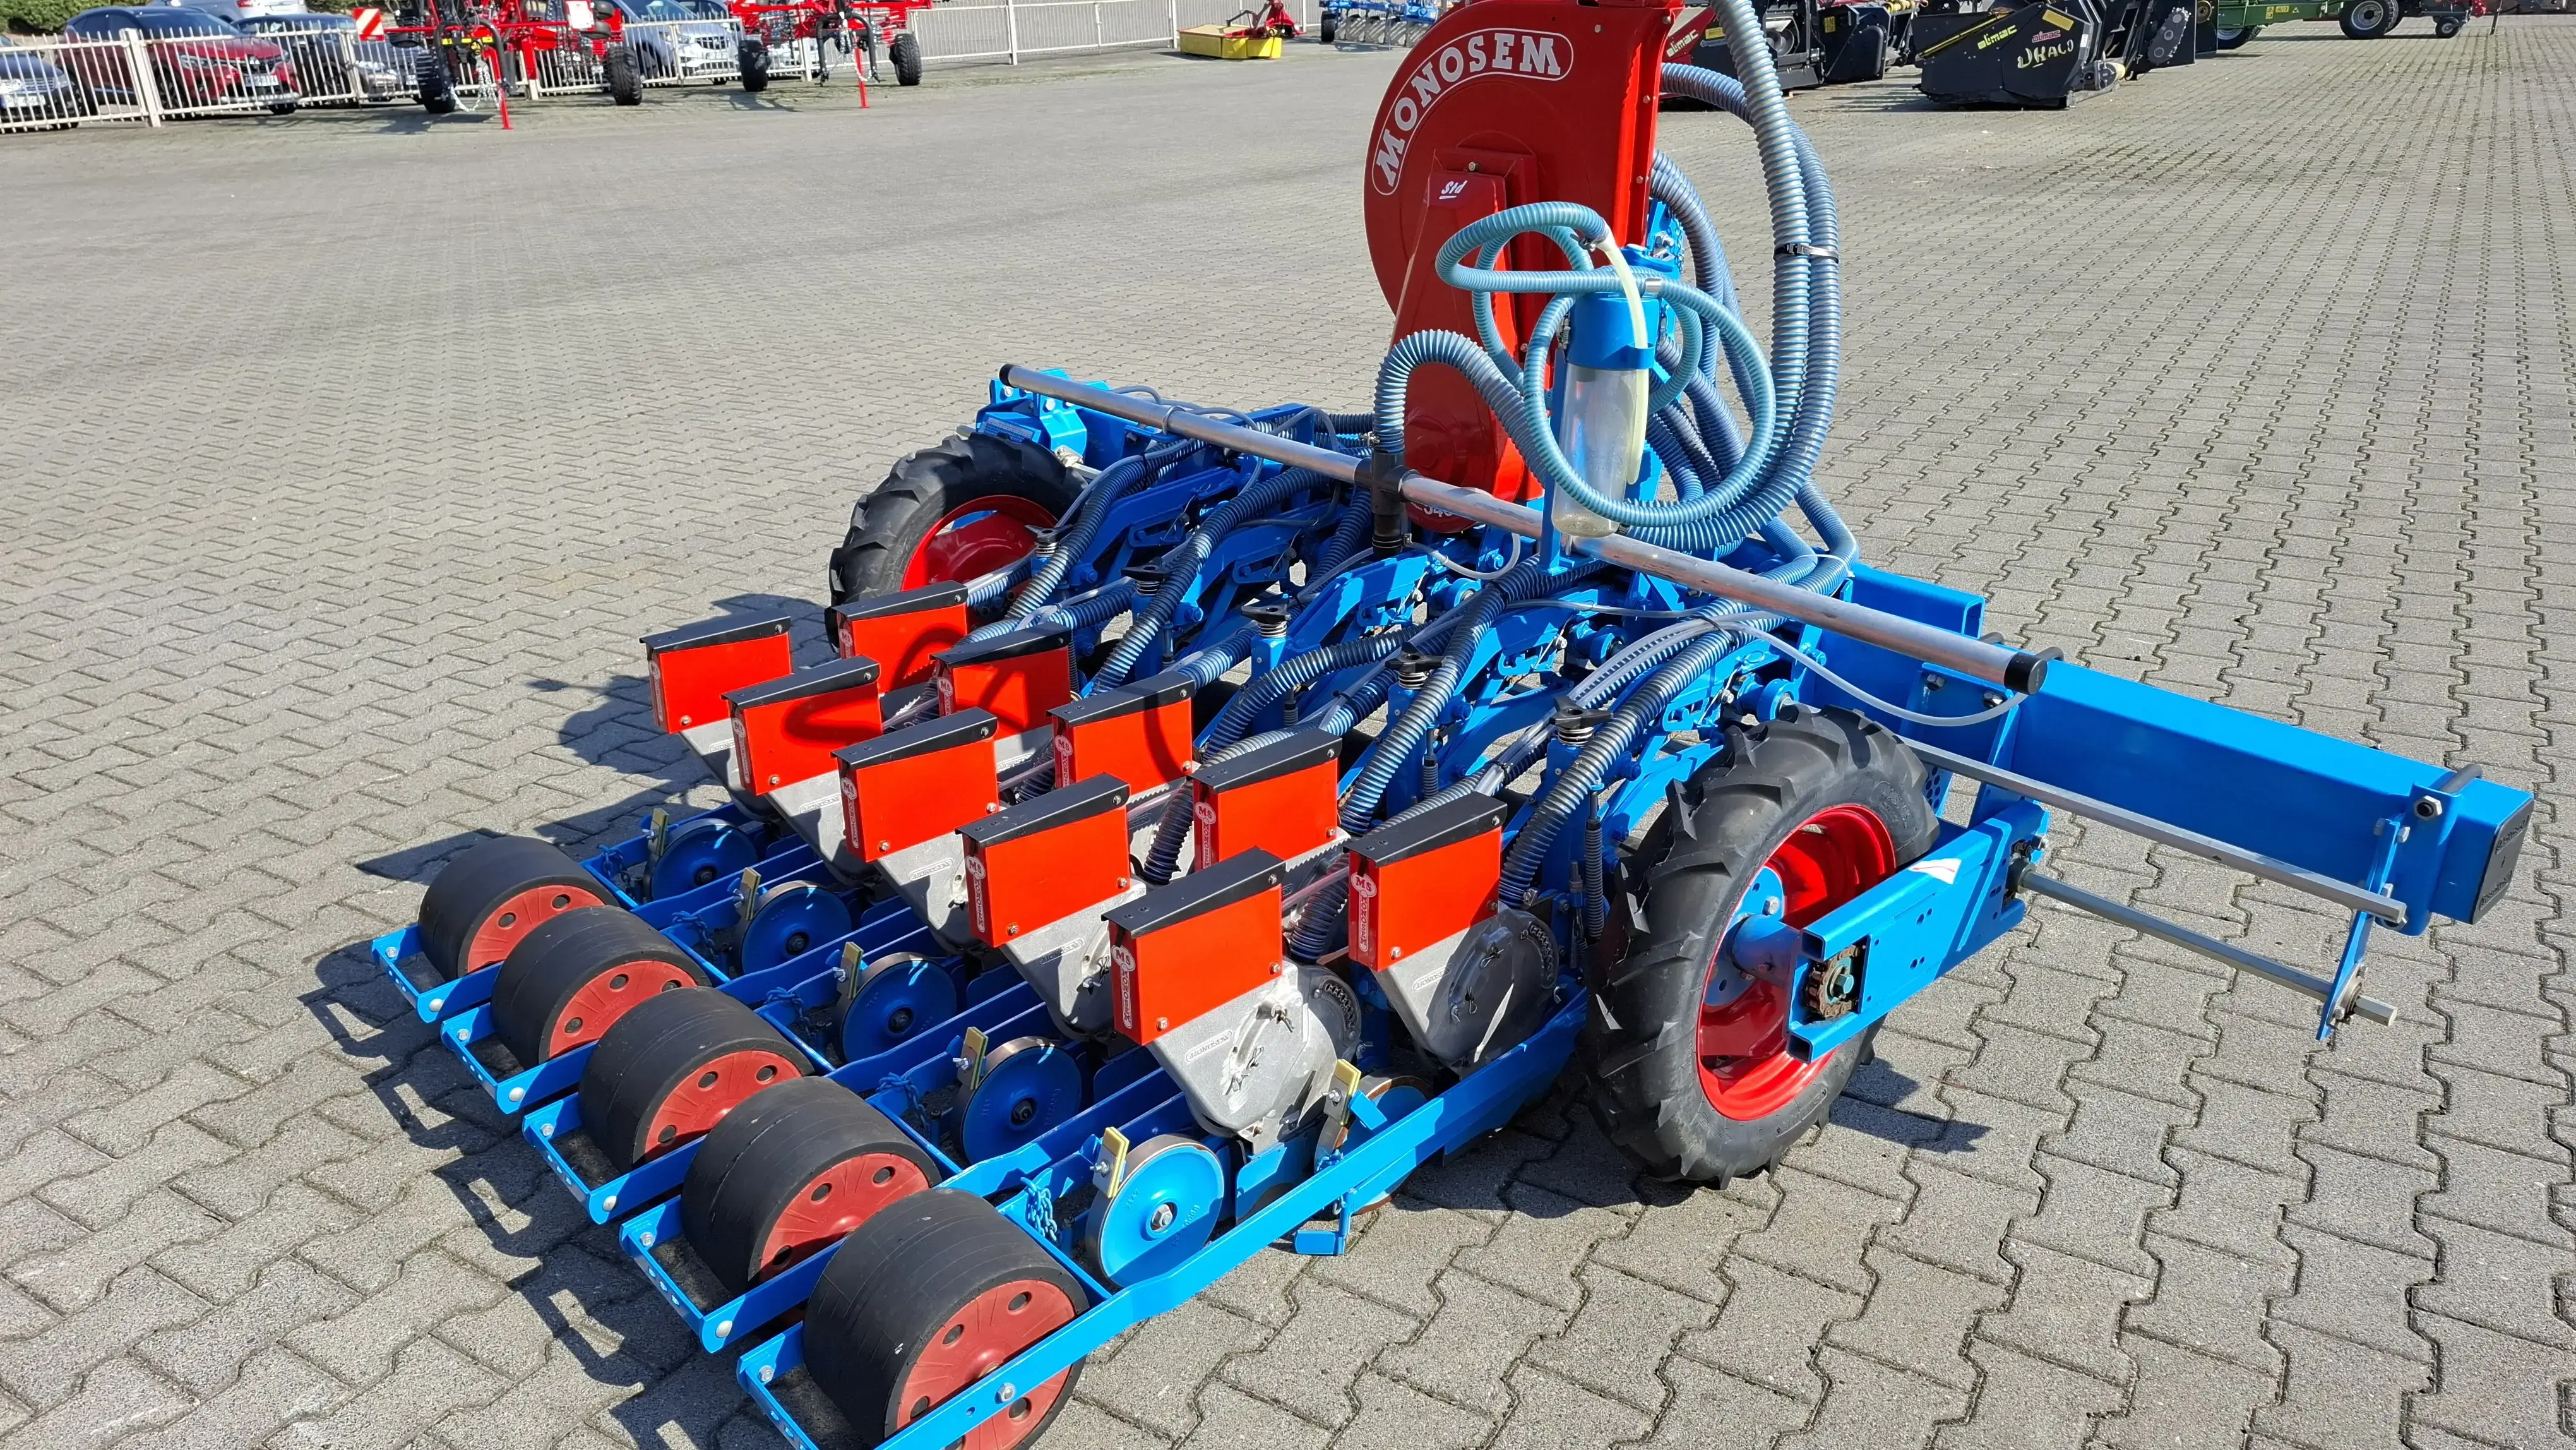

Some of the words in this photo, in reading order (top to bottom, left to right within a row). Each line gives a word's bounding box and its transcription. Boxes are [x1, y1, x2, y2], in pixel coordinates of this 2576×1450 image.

[1376, 32, 1560, 186] MONOSEM
[1440, 180, 1467, 195] Std
[1058, 739, 1070, 751] MS
[1198, 805, 1212, 820] MS
[969, 859, 982, 874] MS
[1356, 876, 1372, 892] MS
[1360, 895, 1368, 946] MONOSEM
[1116, 950, 1131, 966] MS
